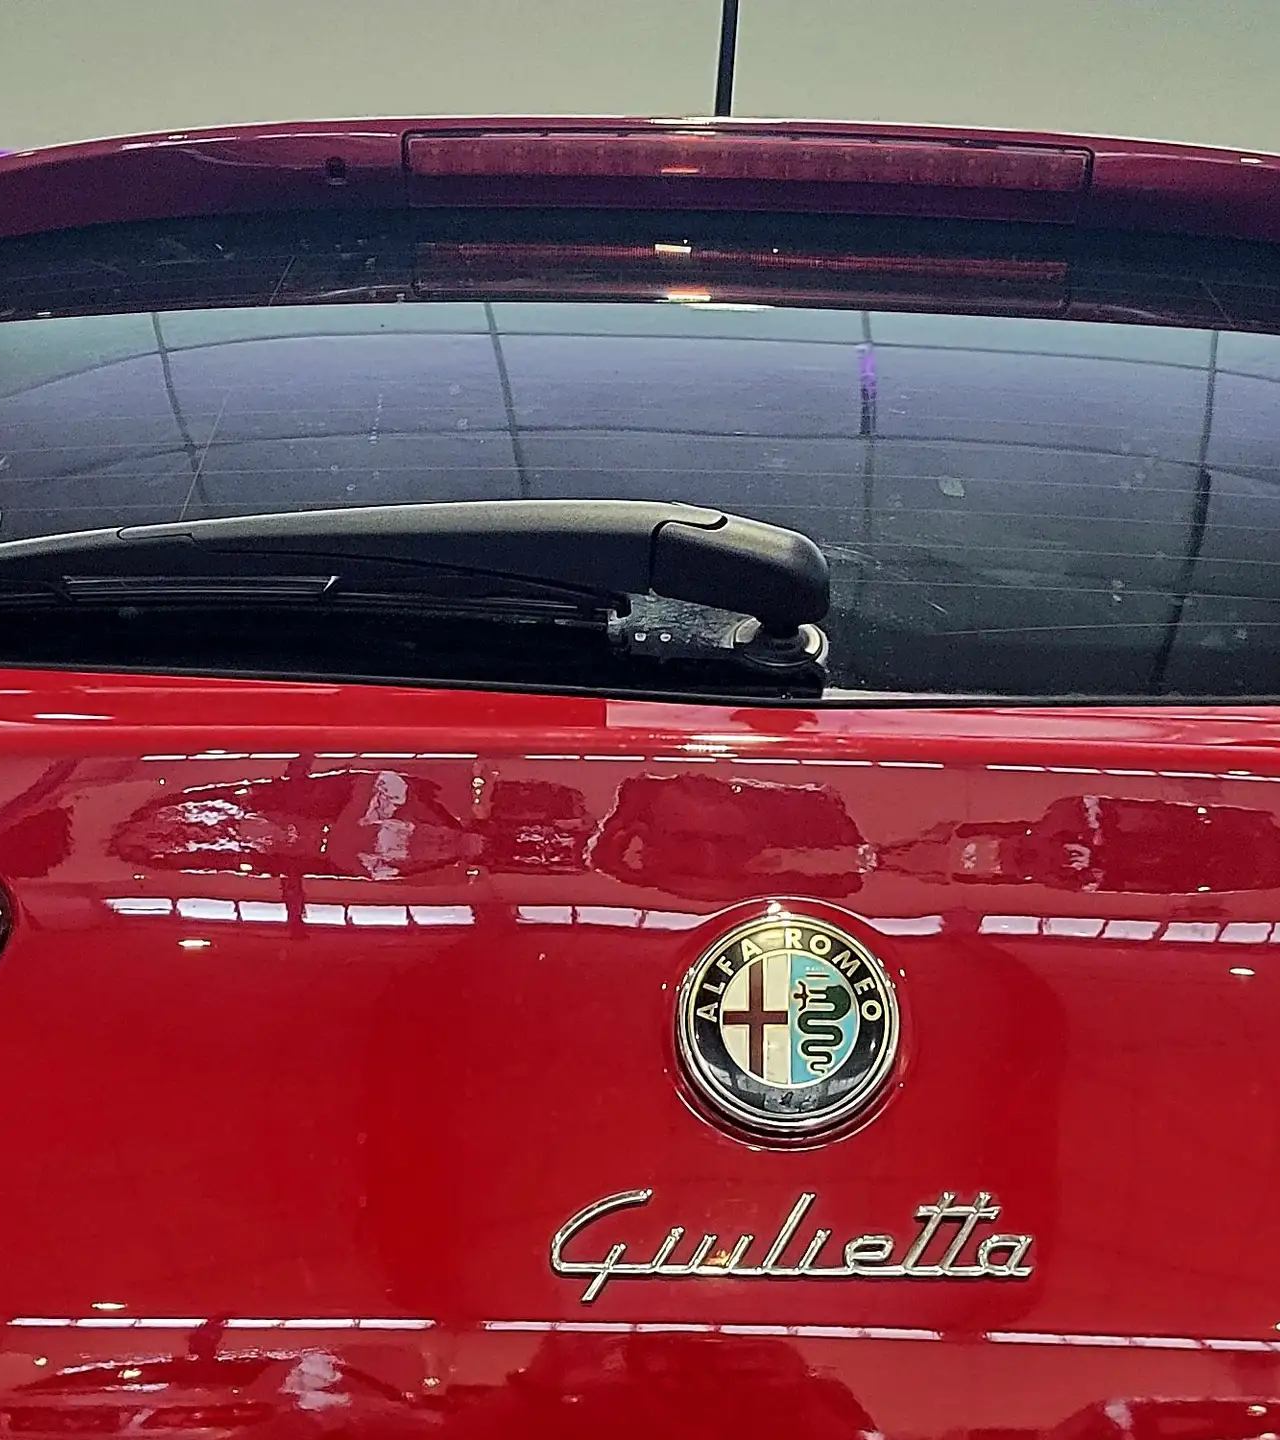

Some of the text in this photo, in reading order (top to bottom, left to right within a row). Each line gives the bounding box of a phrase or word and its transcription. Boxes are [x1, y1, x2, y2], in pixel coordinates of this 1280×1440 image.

[696, 927, 882, 1023] ALFA ROMEO
[550, 1187, 1037, 1305] Giulietta
